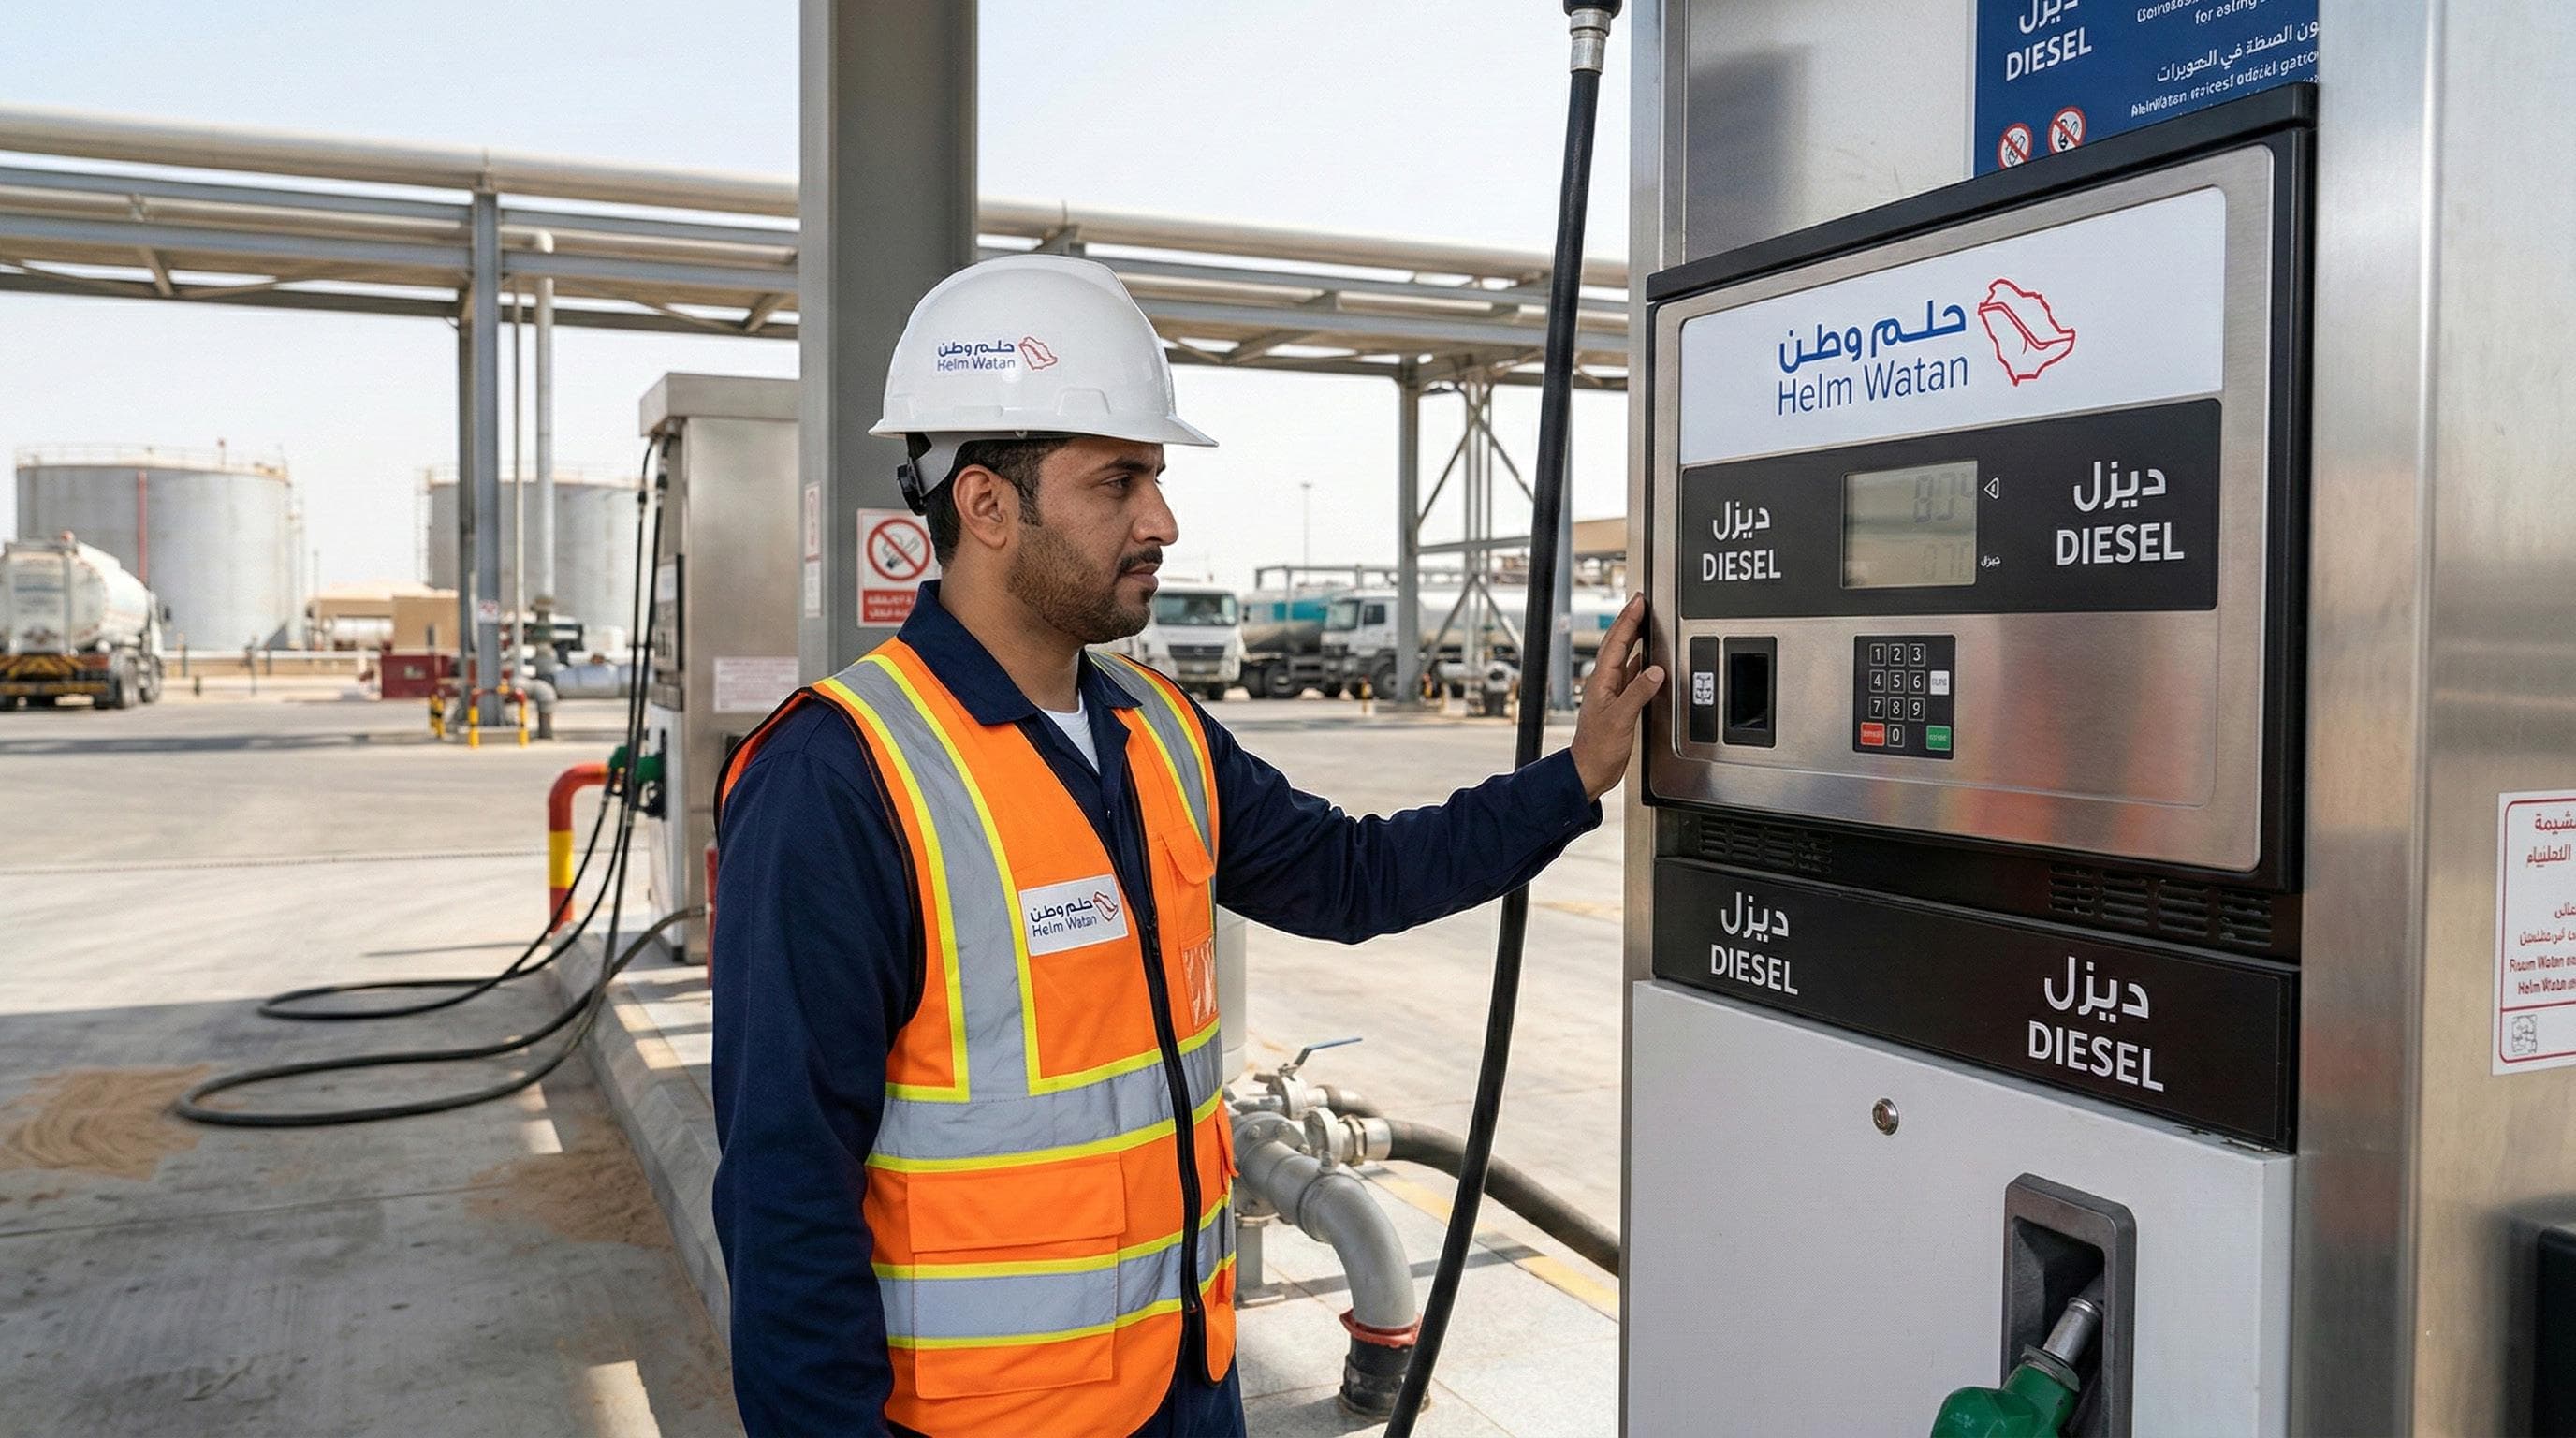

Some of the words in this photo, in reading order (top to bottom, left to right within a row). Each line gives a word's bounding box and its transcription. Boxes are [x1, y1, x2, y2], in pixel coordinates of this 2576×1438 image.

[2006, 26, 2092, 81] DIESEL
[1871, 300, 1967, 358] حلم
[937, 358, 970, 372] Helm
[972, 356, 1016, 370] Watan
[938, 342, 973, 357] وطن
[974, 340, 1015, 356] حلم
[1778, 324, 1863, 374] وطن
[1778, 373, 1852, 416] Helm
[1864, 356, 1968, 401] Watan
[2073, 461, 2166, 511] ديزل
[1713, 501, 1770, 541] ديزل
[2056, 521, 2185, 565] DIESEL
[1703, 549, 1781, 582] DIESEL
[1875, 648, 1881, 661] 1
[1894, 647, 1901, 661] 2
[1912, 647, 1921, 661] 3
[1874, 673, 1881, 687] 4
[1893, 674, 1901, 688] 5
[1912, 675, 1921, 689] 6
[1873, 699, 1881, 713] 7
[1893, 700, 1900, 714] 8
[1912, 701, 1921, 716] 9
[1892, 728, 1900, 742] 0
[1030, 905, 1064, 923] وطن
[1066, 898, 1093, 917] حلم
[1720, 891, 1789, 942] ديزل
[1032, 921, 1064, 937] Helm
[1065, 916, 1098, 930] Watan
[1711, 944, 1798, 995] DIESEL
[2044, 956, 2149, 1023] ديزل
[2028, 1020, 2164, 1092] DIESEL
